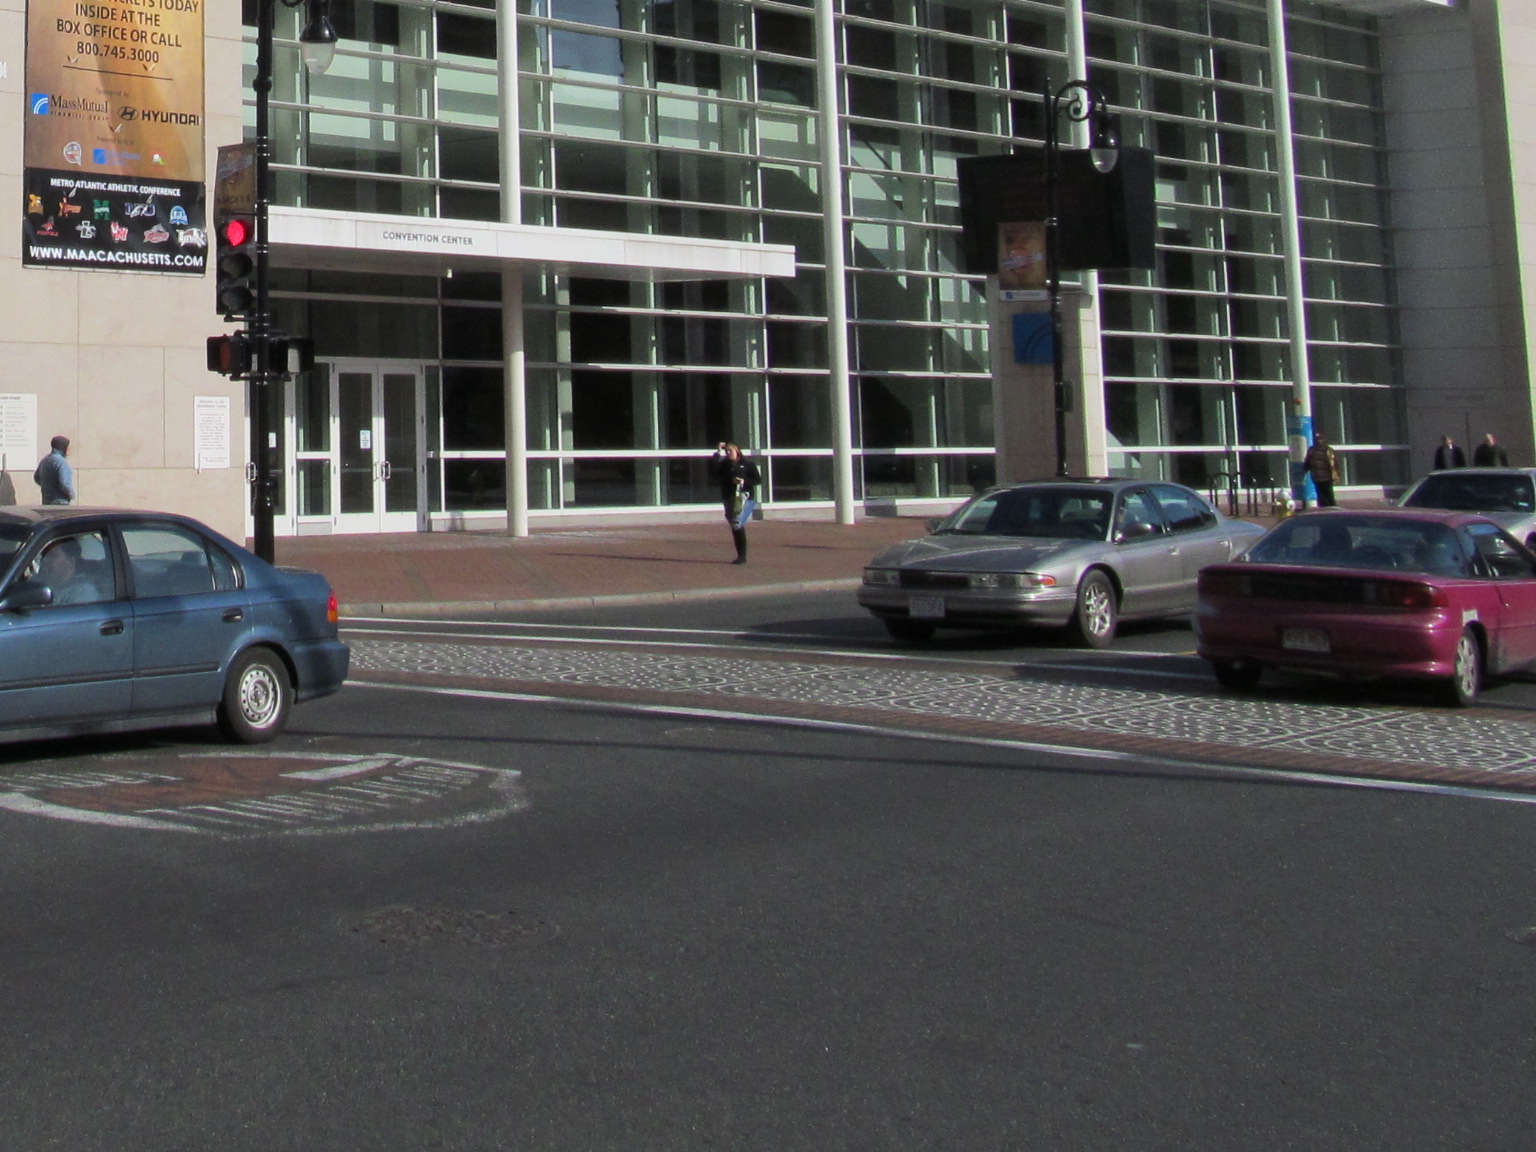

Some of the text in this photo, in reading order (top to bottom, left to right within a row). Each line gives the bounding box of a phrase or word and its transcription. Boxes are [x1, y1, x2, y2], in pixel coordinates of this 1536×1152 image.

[74, 2, 161, 27] INSIDE AT THE
[56, 17, 183, 48] BOX OFFICE OR CALL
[76, 40, 160, 64] 800.745.3000
[50, 94, 199, 126] MassMutual HYUNDAI
[50, 177, 181, 196] METRO ATLANTIC ATHLETIC CONFERENCE
[383, 231, 473, 245] CONVENTION CENTER
[29, 246, 203, 267] WWW.MAACACHUSETTS.COM
